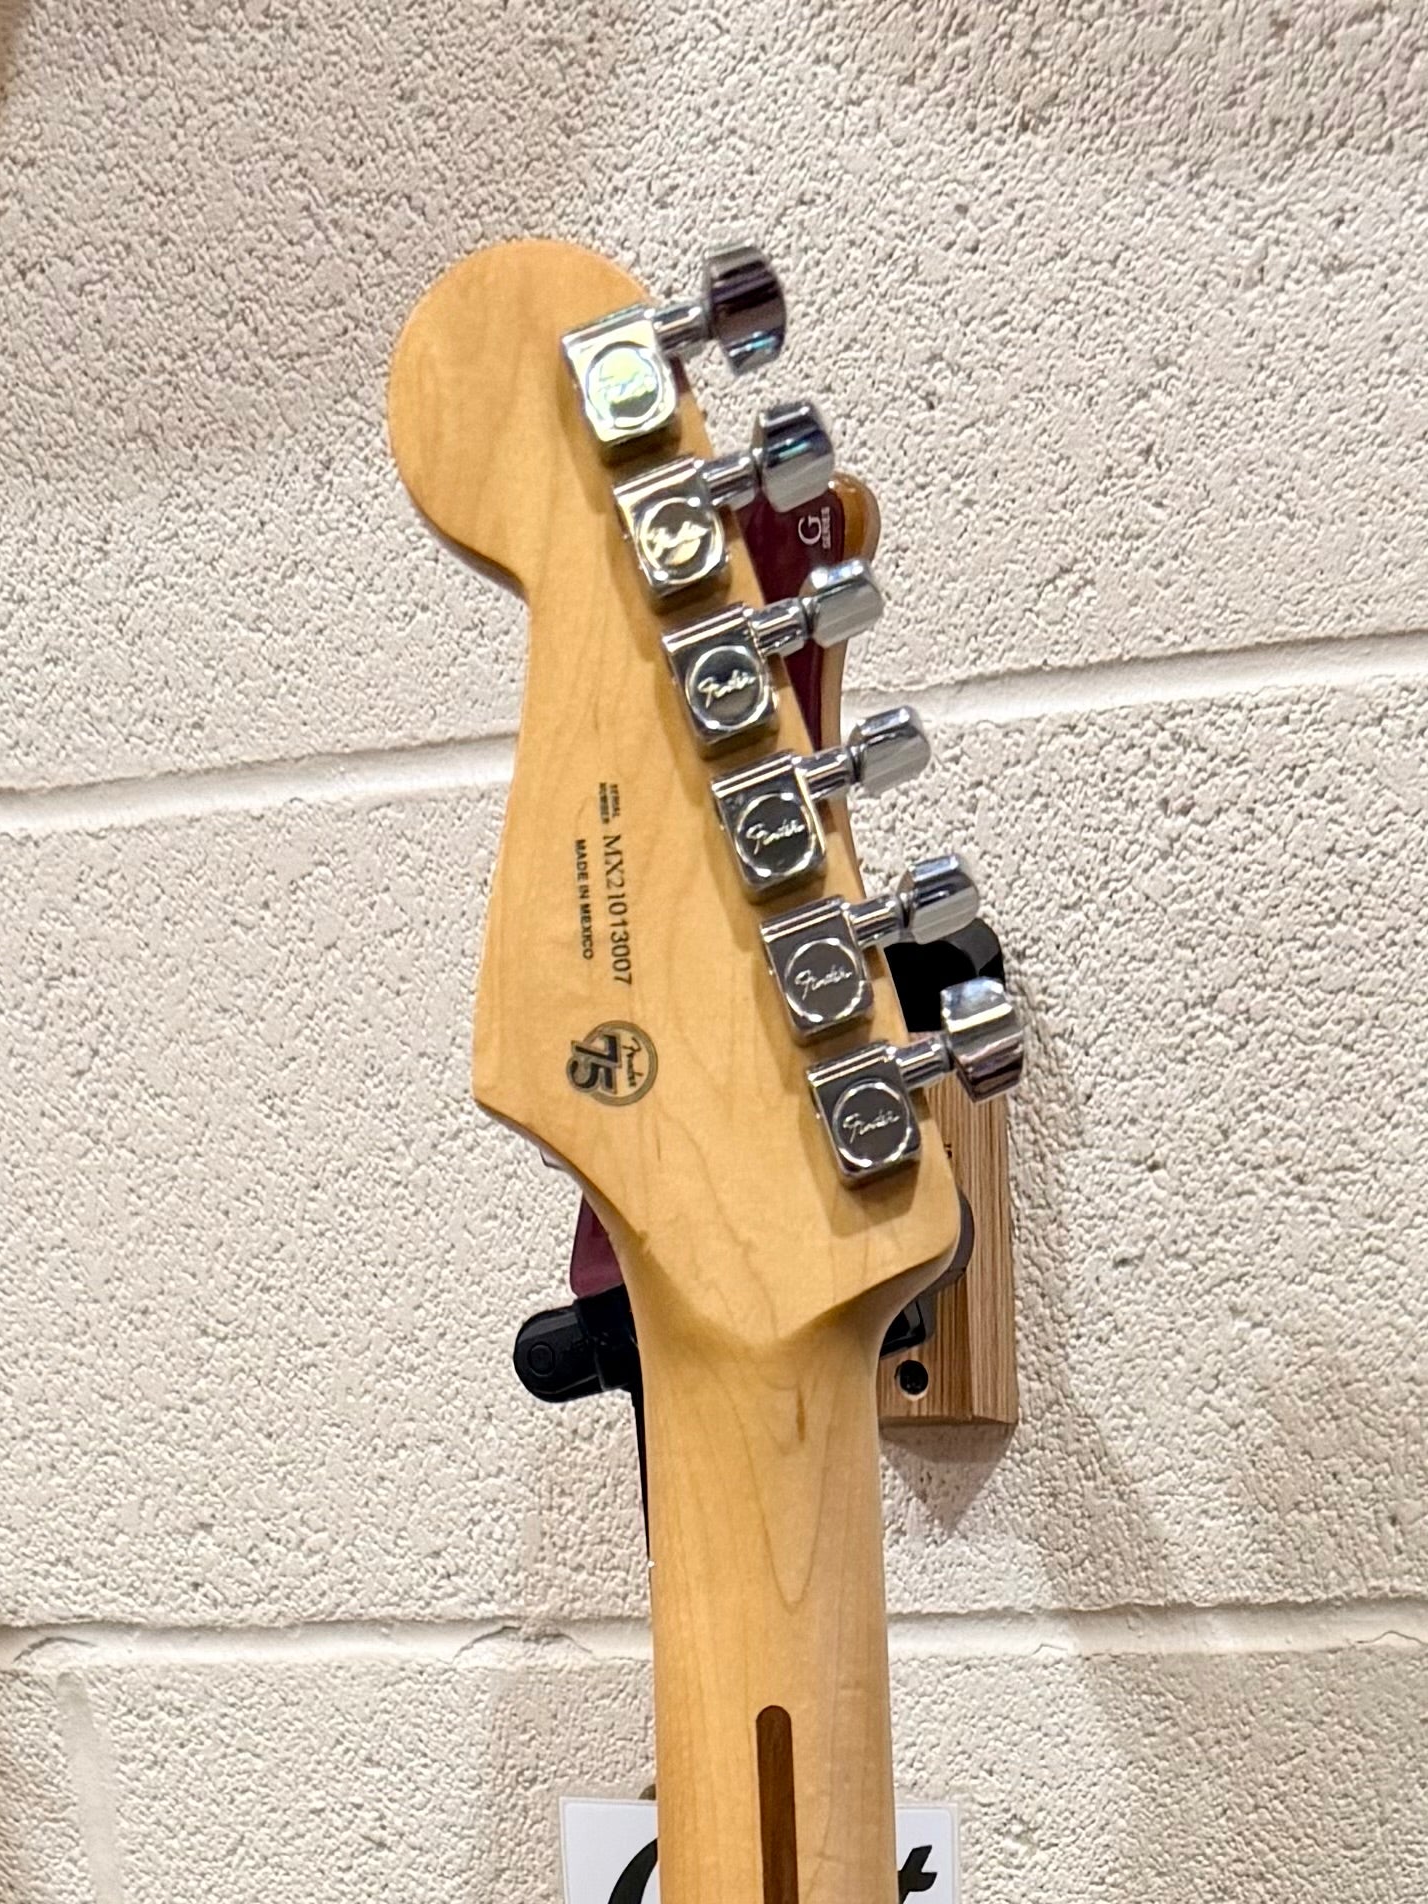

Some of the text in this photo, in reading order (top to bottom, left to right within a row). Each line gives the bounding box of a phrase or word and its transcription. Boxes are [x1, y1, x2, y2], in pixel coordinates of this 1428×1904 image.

[798, 515, 822, 546] G
[575, 839, 594, 960] MADE IN MEXICO
[603, 834, 633, 986] MX21013007
[794, 964, 853, 1000] Fender
[571, 1033, 621, 1093] 75
[842, 1109, 900, 1143] Fender
